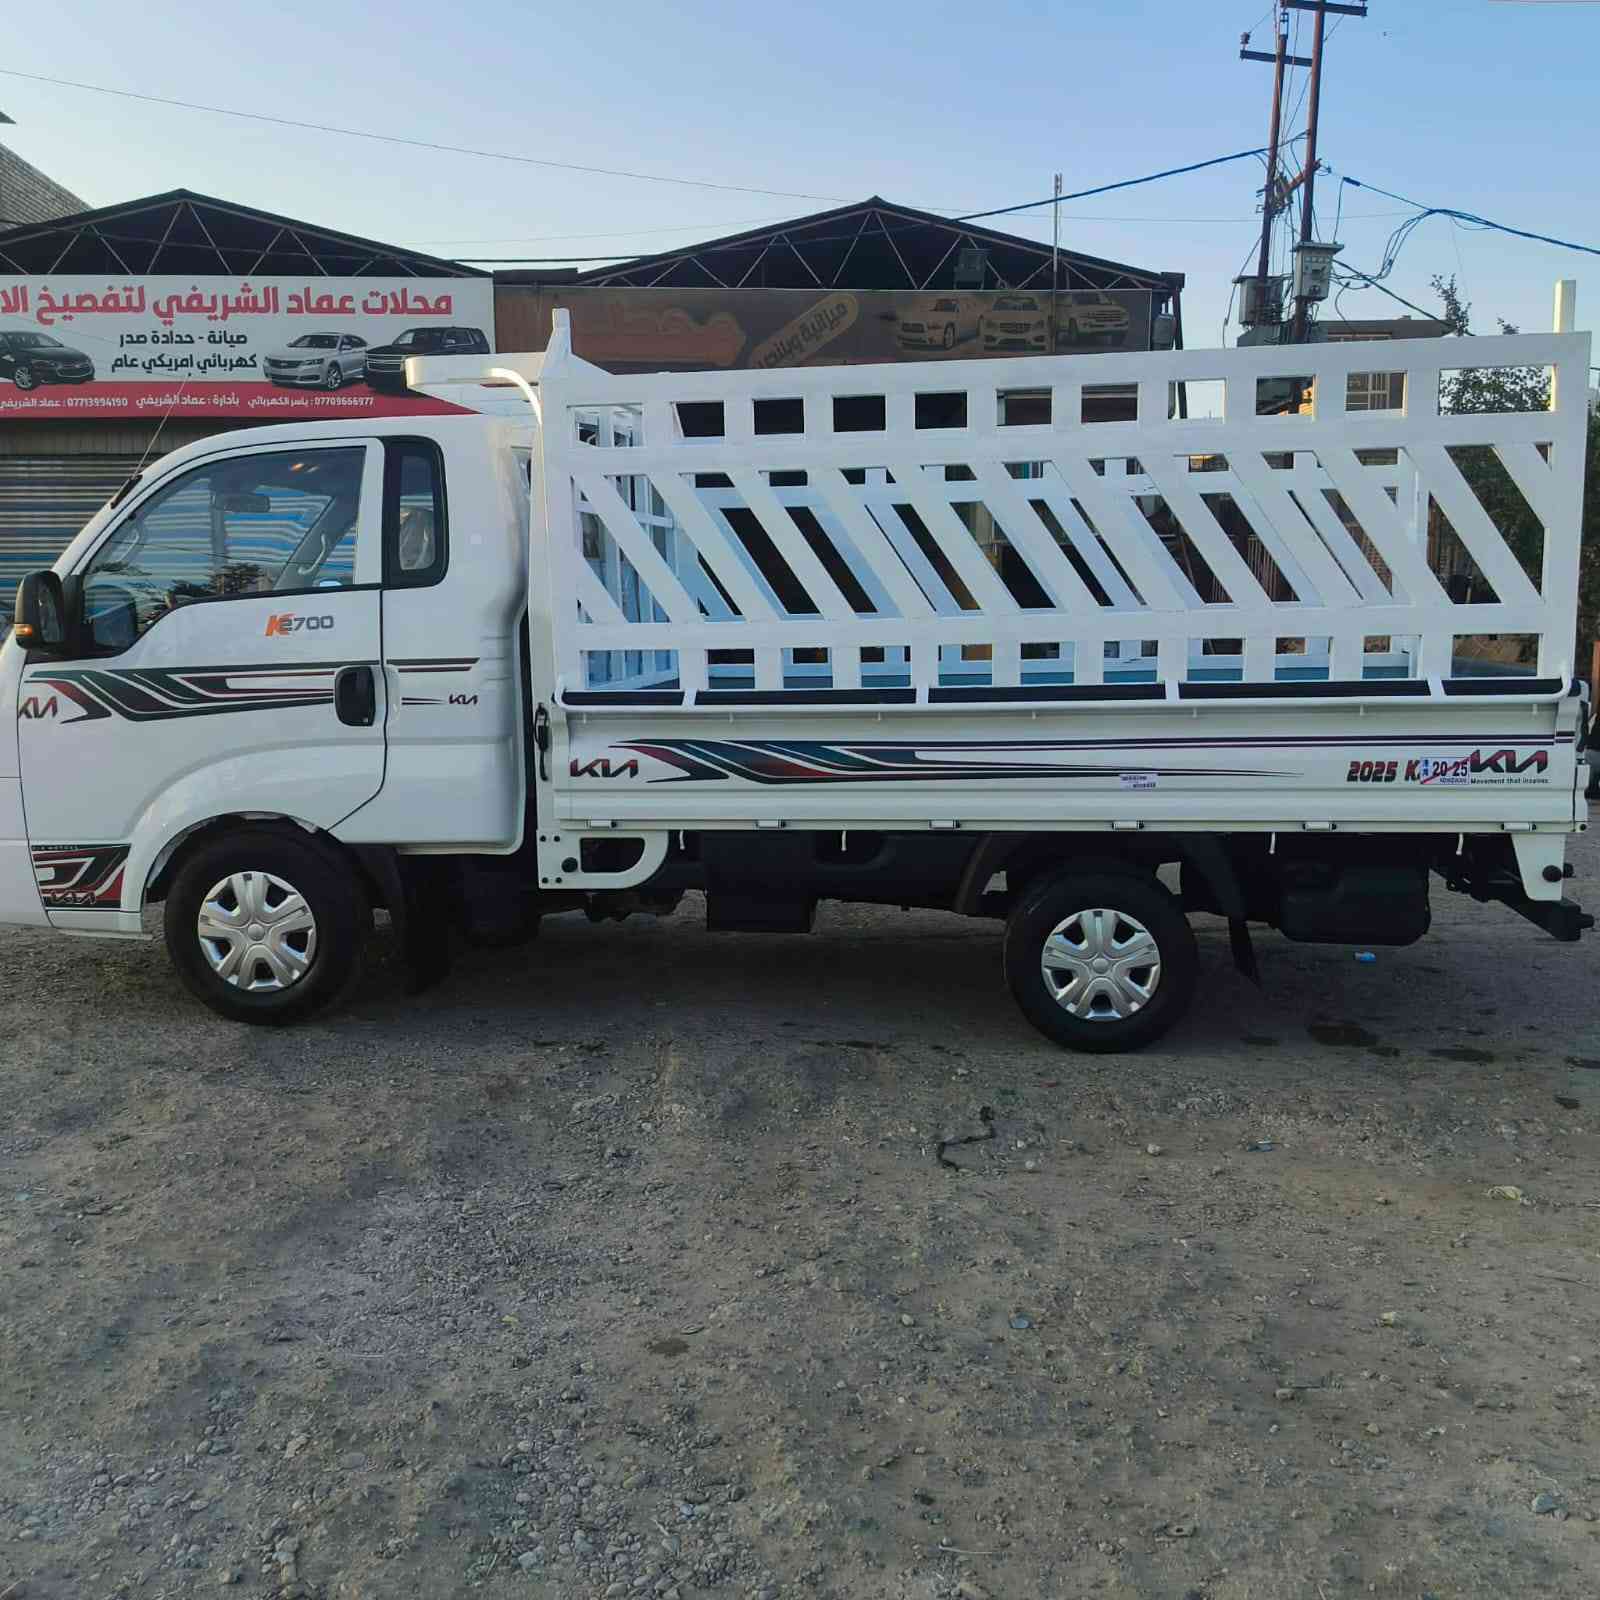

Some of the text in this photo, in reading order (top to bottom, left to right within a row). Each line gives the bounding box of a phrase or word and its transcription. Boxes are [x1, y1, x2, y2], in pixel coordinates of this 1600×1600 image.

[36, 284, 146, 326] لتفصيخ
[152, 282, 279, 327] الشريفي
[286, 286, 356, 315] عماد
[362, 287, 452, 315] محلات
[119, 333, 148, 348] صدر
[150, 330, 195, 345] حدادة
[207, 330, 248, 348] صيانة
[111, 352, 257, 374] كهربائي امريكي عام
[569, 758, 639, 779] KIA
[1346, 760, 1398, 782] 2025
